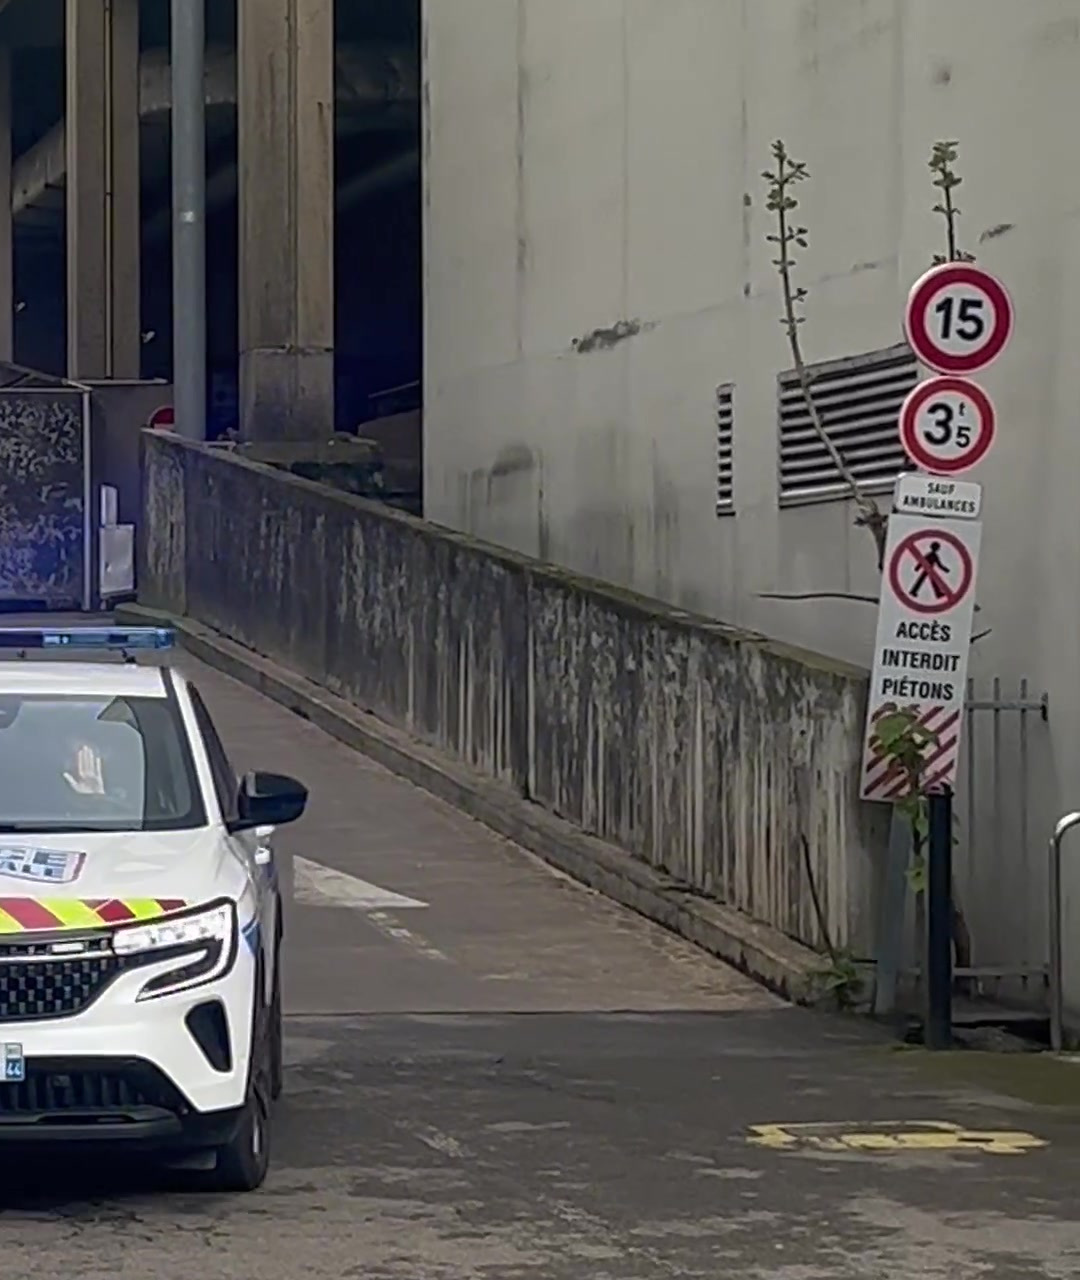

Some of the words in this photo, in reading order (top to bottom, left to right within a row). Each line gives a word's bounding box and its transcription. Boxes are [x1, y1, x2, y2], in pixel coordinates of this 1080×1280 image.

[935, 297, 984, 342] 15
[928, 482, 955, 495] SAUF
[903, 495, 975, 513] AMBULANCES
[896, 620, 951, 642] ACCÈS
[881, 649, 961, 672] INTERDIT
[881, 675, 954, 700] PIÉTONS
